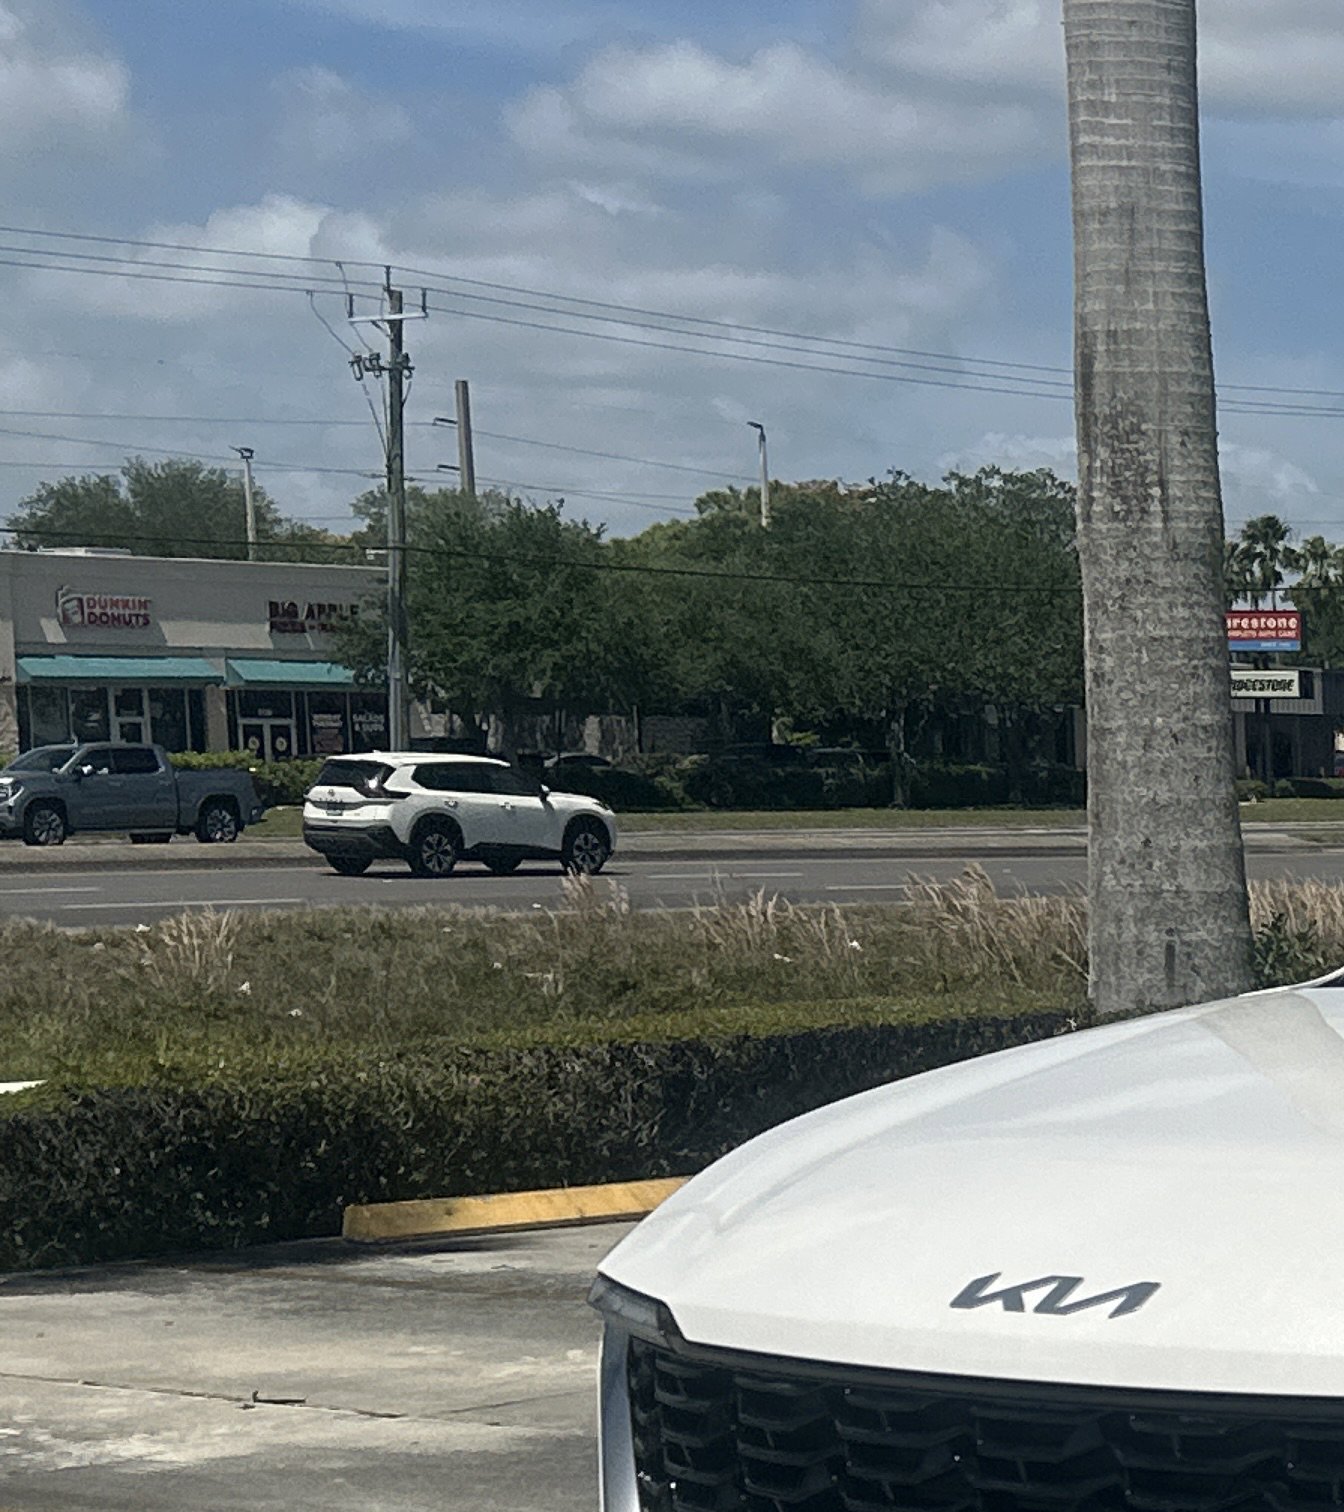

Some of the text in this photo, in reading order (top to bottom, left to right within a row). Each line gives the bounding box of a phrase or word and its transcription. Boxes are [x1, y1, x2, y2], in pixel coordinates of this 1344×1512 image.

[87, 611, 151, 626] DONUTS
[1227, 617, 1298, 629] irestone
[950, 1271, 1162, 1319] KIA
